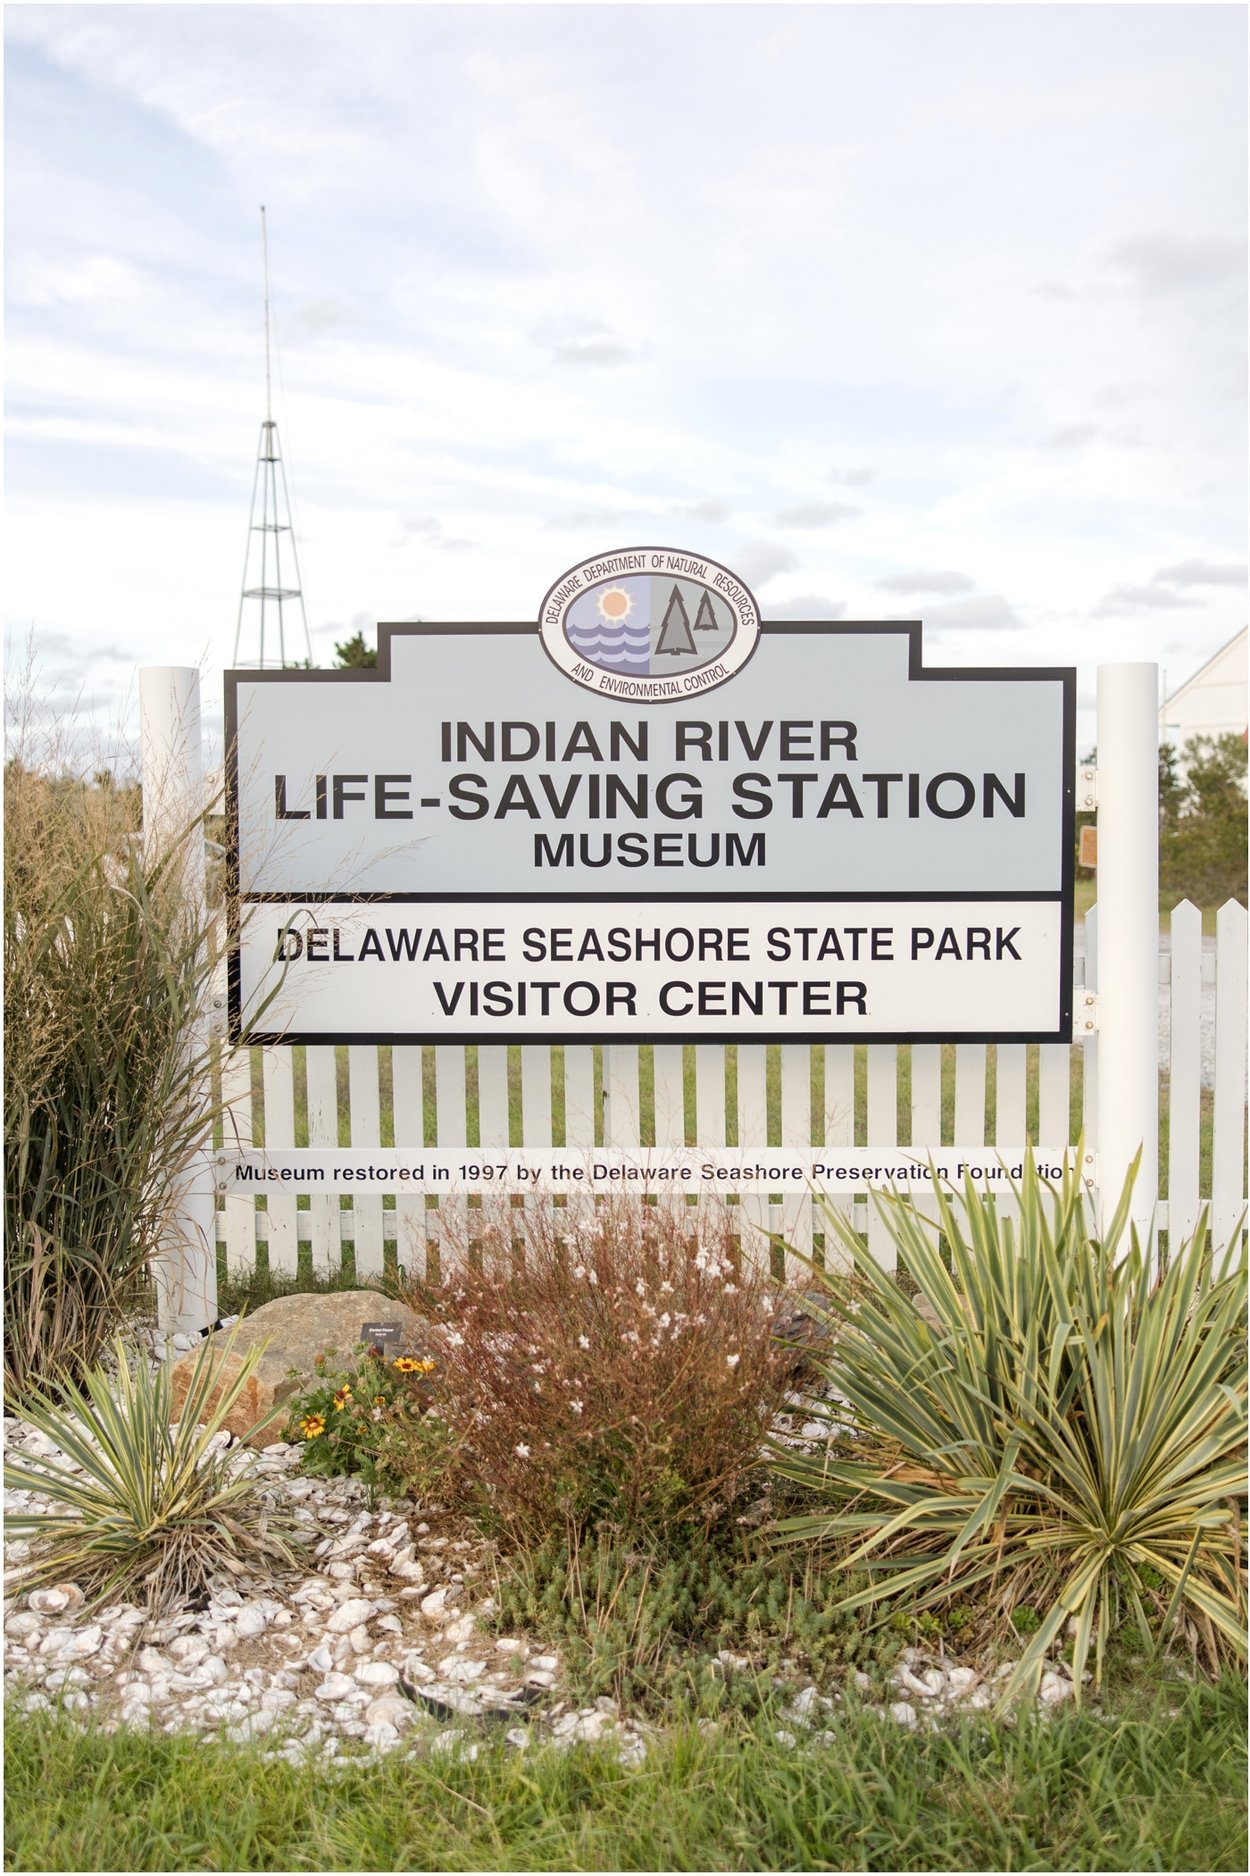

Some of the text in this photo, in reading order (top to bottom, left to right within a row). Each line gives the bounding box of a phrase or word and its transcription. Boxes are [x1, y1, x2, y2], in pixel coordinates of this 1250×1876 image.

[546, 555, 755, 625] DELAWARE DEPARTMENT OF NATURAL RESOURCES
[571, 663, 729, 696] AND ENVIRONMENTAL CONTROL
[440, 720, 858, 763] INDIAN RIVER
[275, 772, 1026, 821] LIFE-SAVING STATION
[534, 832, 766, 867] MUSEUM
[277, 927, 1022, 962] DELAWARE SEASHORE STATE PARK
[433, 981, 868, 1017] VISITOR CENTER
[236, 1163, 1076, 1184] Museum restored in 1997 by the Delaware Seashore Preservation Foundtio
